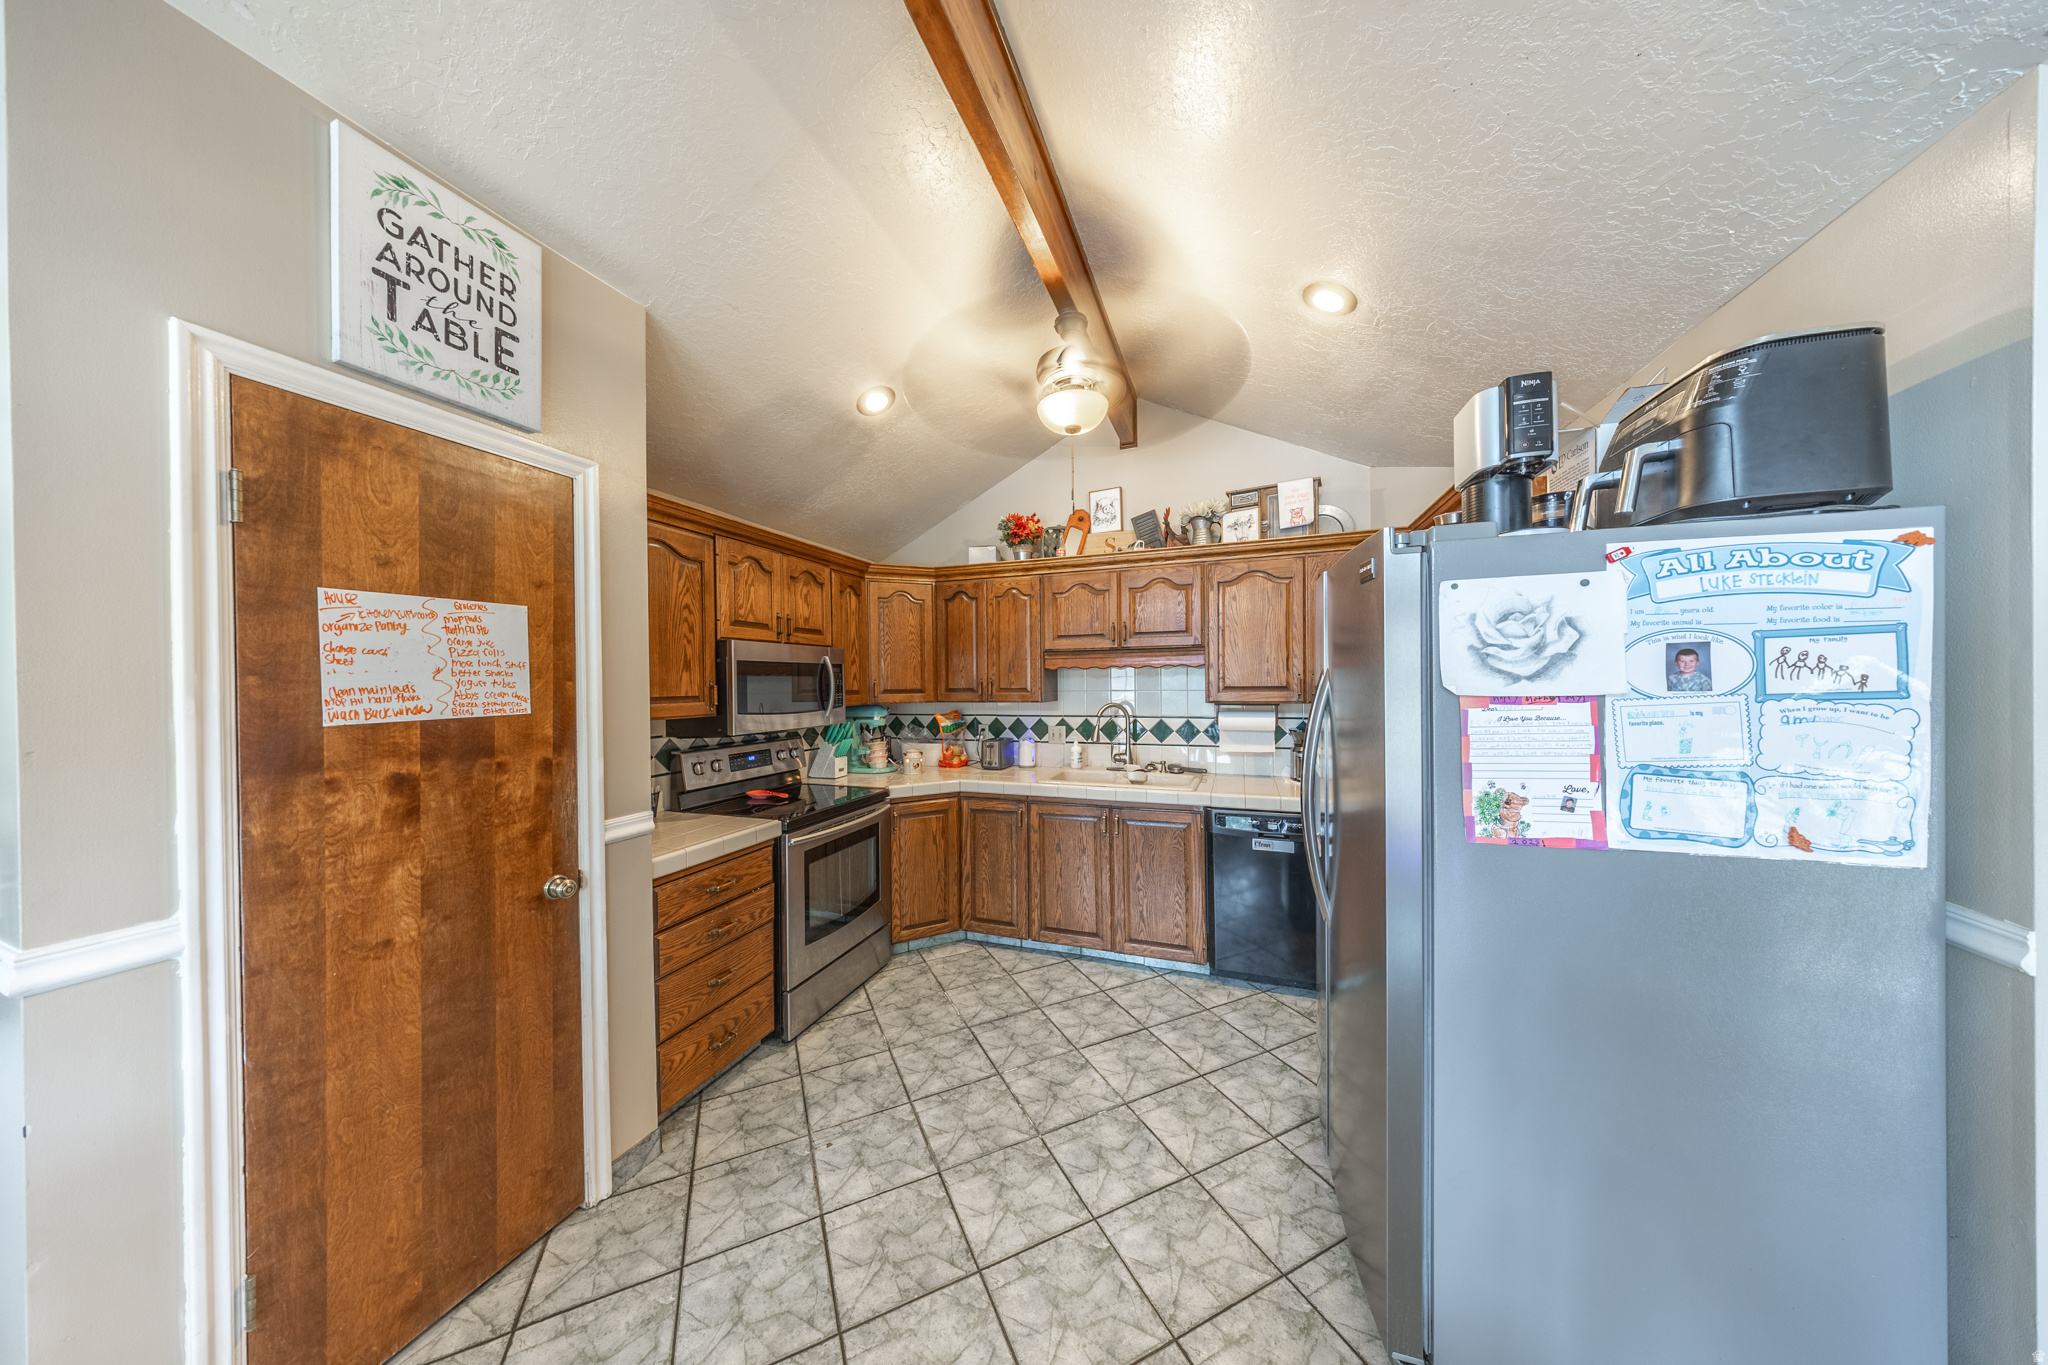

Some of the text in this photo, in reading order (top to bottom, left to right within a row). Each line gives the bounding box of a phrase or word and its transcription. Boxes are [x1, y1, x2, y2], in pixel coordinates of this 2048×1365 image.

[377, 207, 517, 303] GATHER
[375, 242, 518, 328] AROUND
[420, 295, 483, 330] the
[371, 266, 520, 376] TABLE
[1521, 379, 1541, 388] NINJA
[1567, 441, 1589, 460] Carlson
[1656, 547, 1874, 579] All About
[1700, 574, 1742, 592] LUKE
[1766, 605, 1777, 614] My
[1630, 620, 1640, 628] My
[1766, 617, 1777, 625] My
[321, 621, 373, 636] organize
[1646, 637, 1662, 646] This
[478, 659, 501, 668] lunch
[451, 667, 480, 677] better
[491, 678, 516, 689] tubes
[1779, 707, 1801, 715] When
[1688, 779, 1706, 787] thing
[1790, 781, 1803, 789] had
[1839, 782, 1861, 790] would
[1863, 783, 1878, 792] wish
[1562, 784, 1590, 795] Love,
